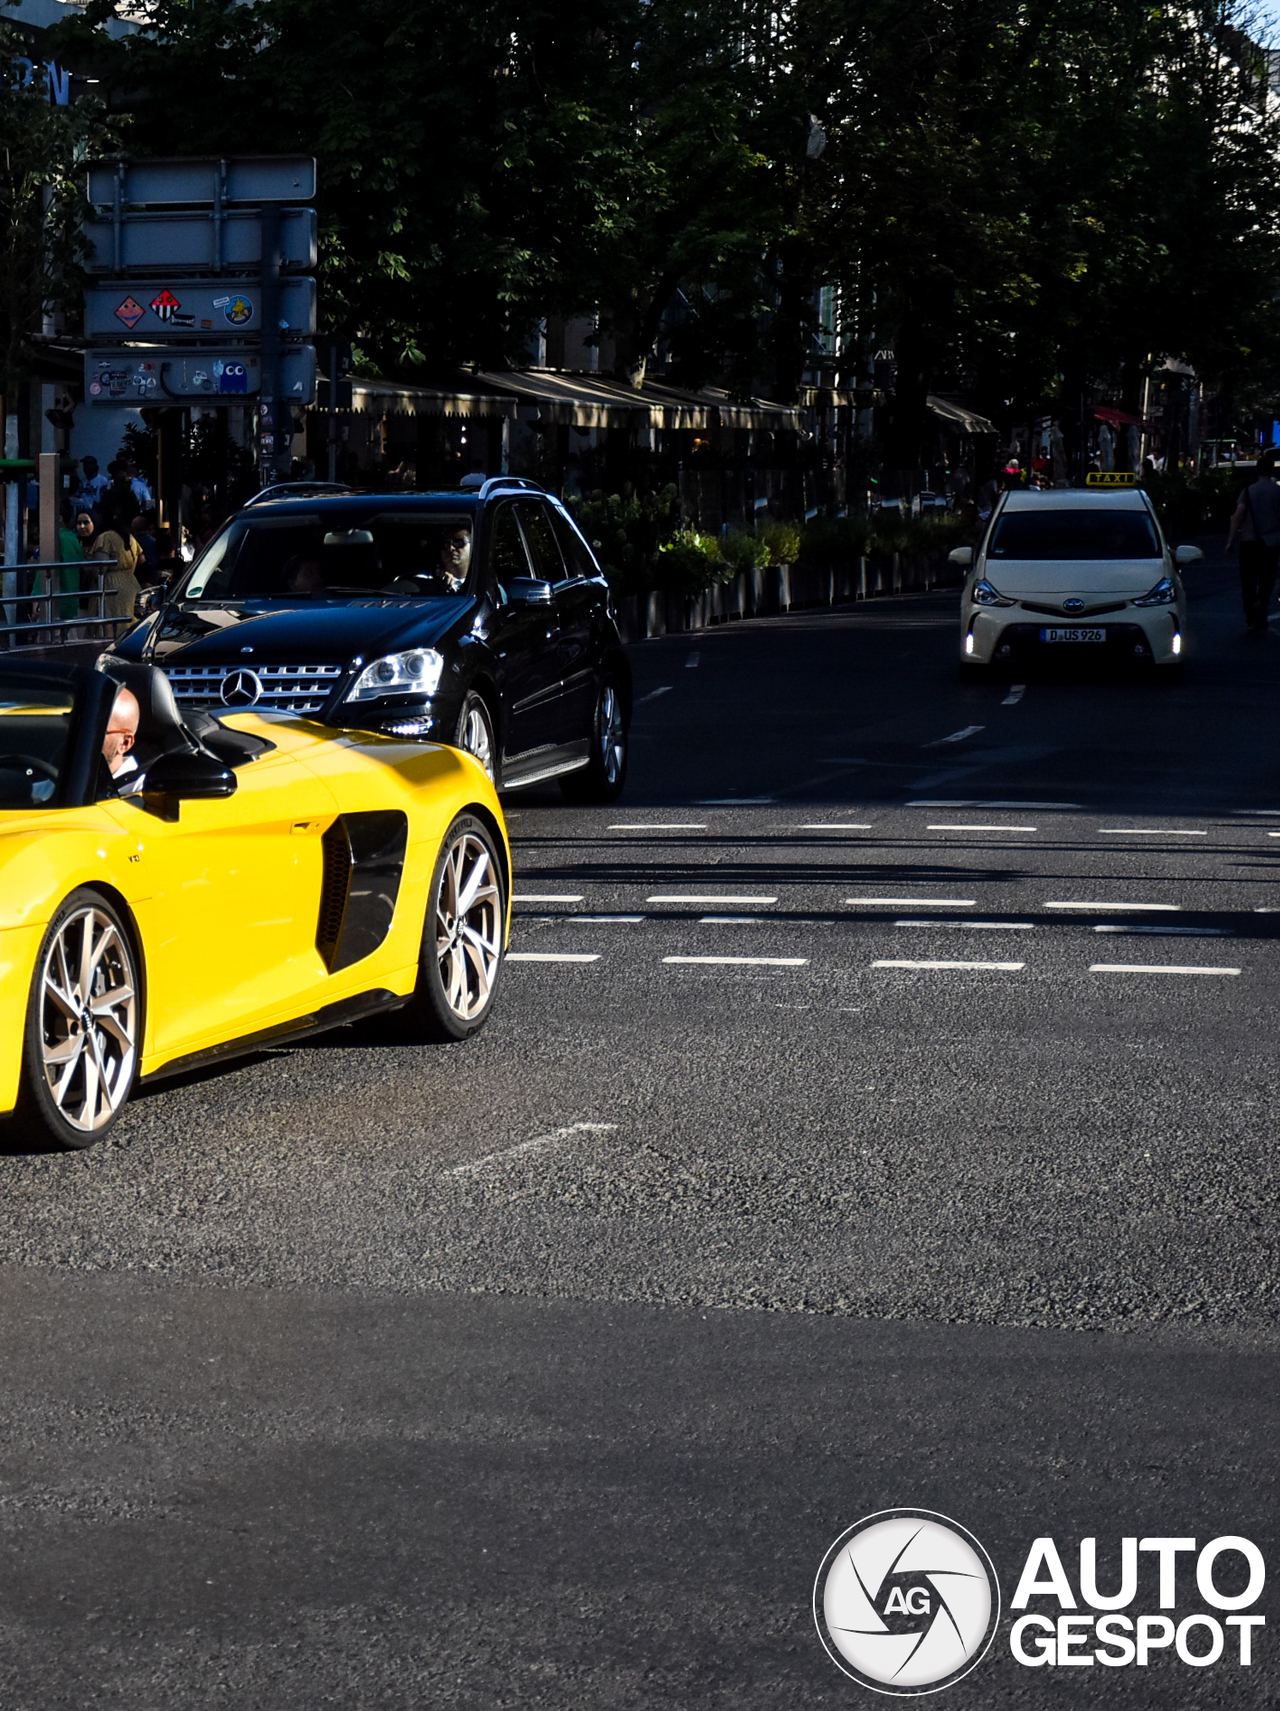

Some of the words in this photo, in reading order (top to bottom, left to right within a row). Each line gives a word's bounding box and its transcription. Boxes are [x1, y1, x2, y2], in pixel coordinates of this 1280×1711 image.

[1094, 473, 1129, 483] TAXI
[1050, 630, 1058, 641] D
[1064, 630, 1079, 641] US
[1081, 630, 1102, 641] 926
